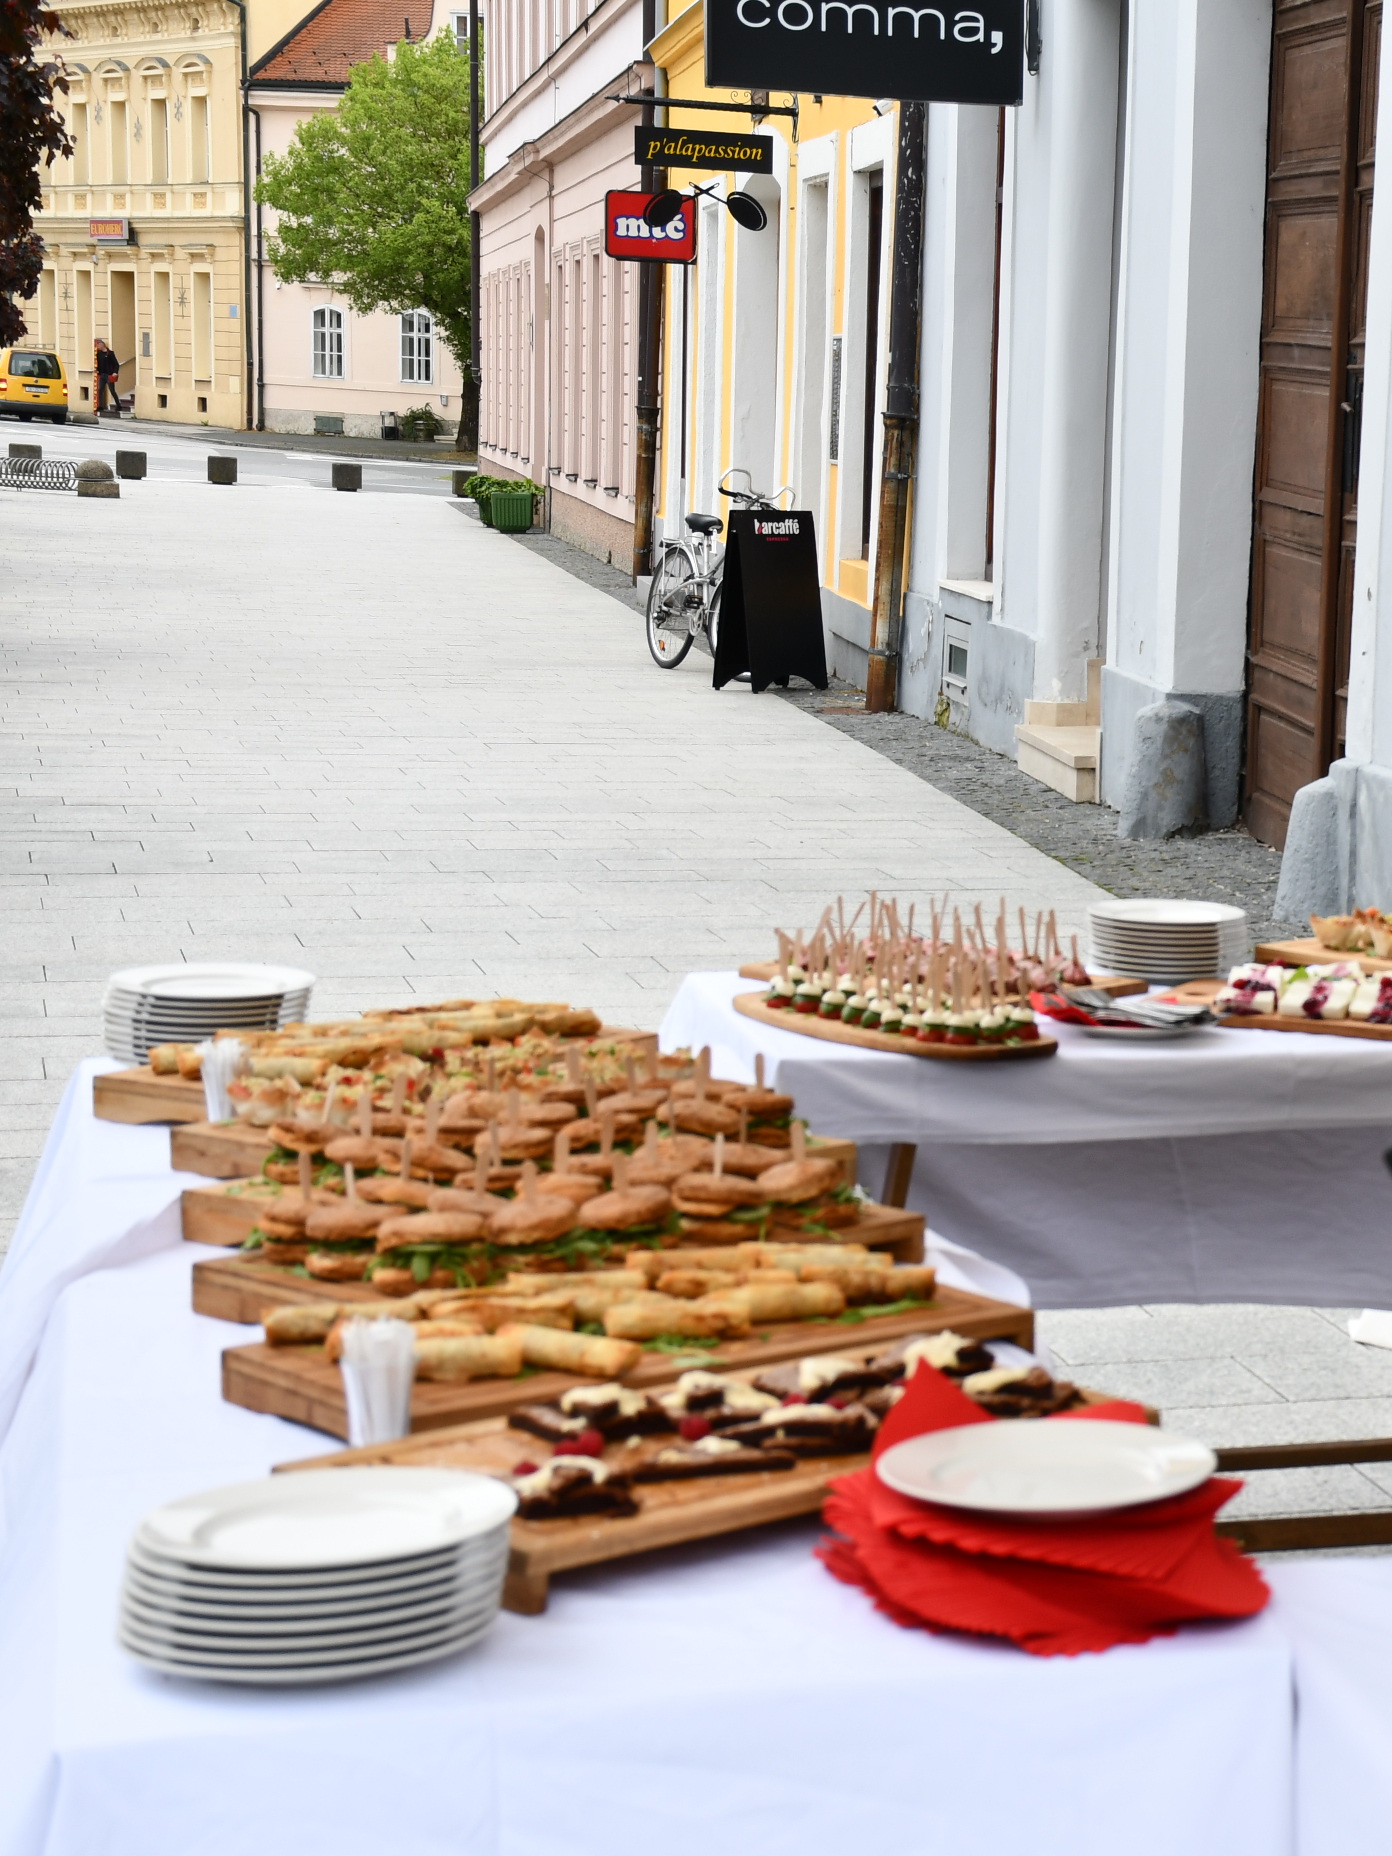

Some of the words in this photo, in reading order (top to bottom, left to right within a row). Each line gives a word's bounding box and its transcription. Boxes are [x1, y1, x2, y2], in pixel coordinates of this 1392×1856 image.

[736, 0, 1004, 55] comma,
[646, 136, 763, 162] p'alapassion
[754, 518, 800, 535] barcaffé
